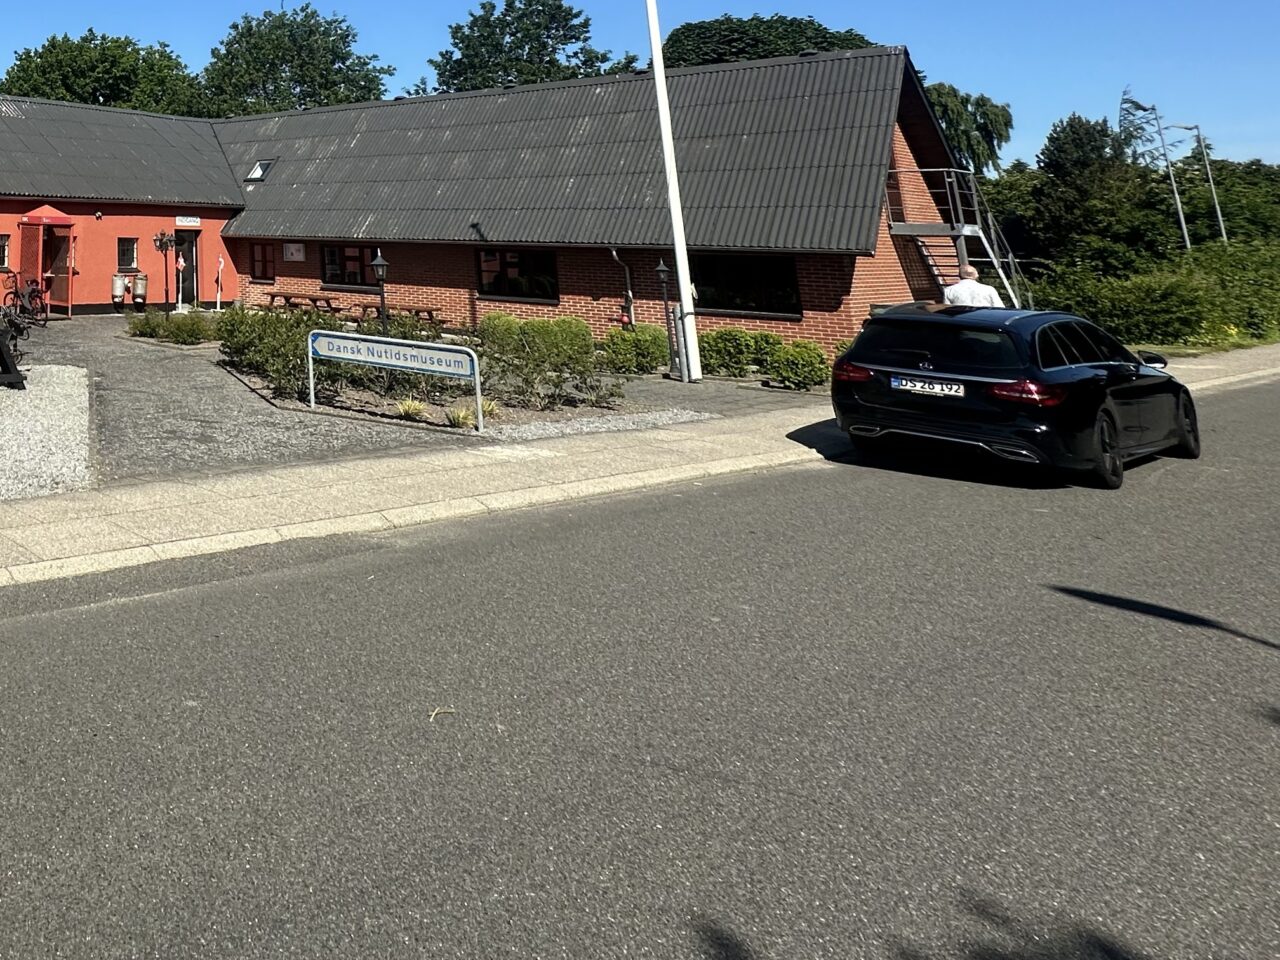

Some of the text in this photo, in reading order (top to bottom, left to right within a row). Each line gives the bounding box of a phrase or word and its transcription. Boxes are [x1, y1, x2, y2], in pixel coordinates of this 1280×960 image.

[327, 341, 464, 369] Dansk Nutidsmuseum
[900, 378, 917, 388] DS
[920, 380, 935, 391] 26
[939, 382, 961, 394] 192
